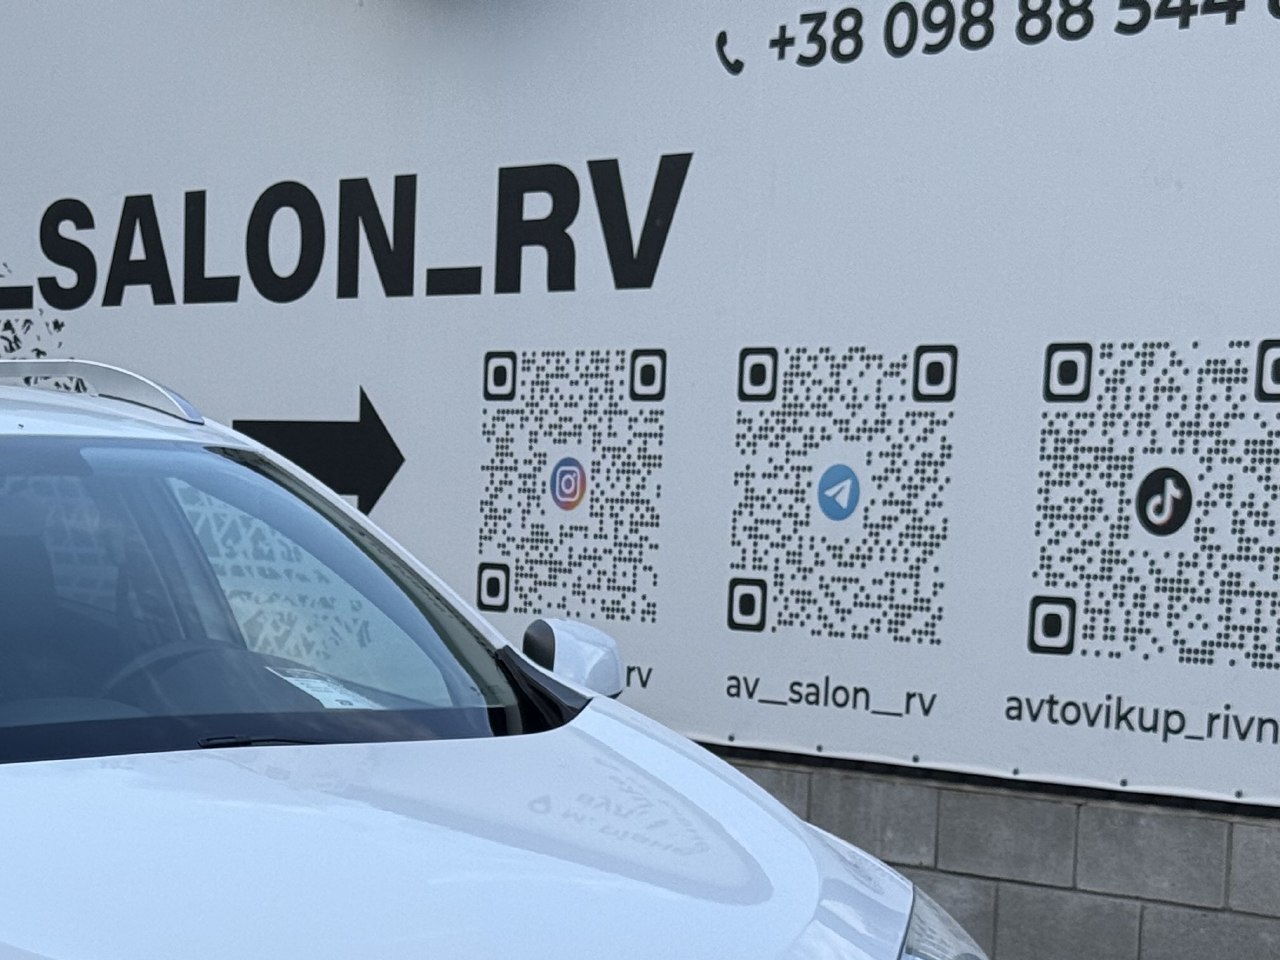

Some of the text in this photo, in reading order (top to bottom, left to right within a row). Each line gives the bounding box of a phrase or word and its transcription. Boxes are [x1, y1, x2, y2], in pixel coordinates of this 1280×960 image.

[769, 7, 864, 68] +38
[883, 0, 995, 59] 098
[1015, 0, 1095, 46] 88
[1004, 694, 1280, 745] avtovikup_rivn
